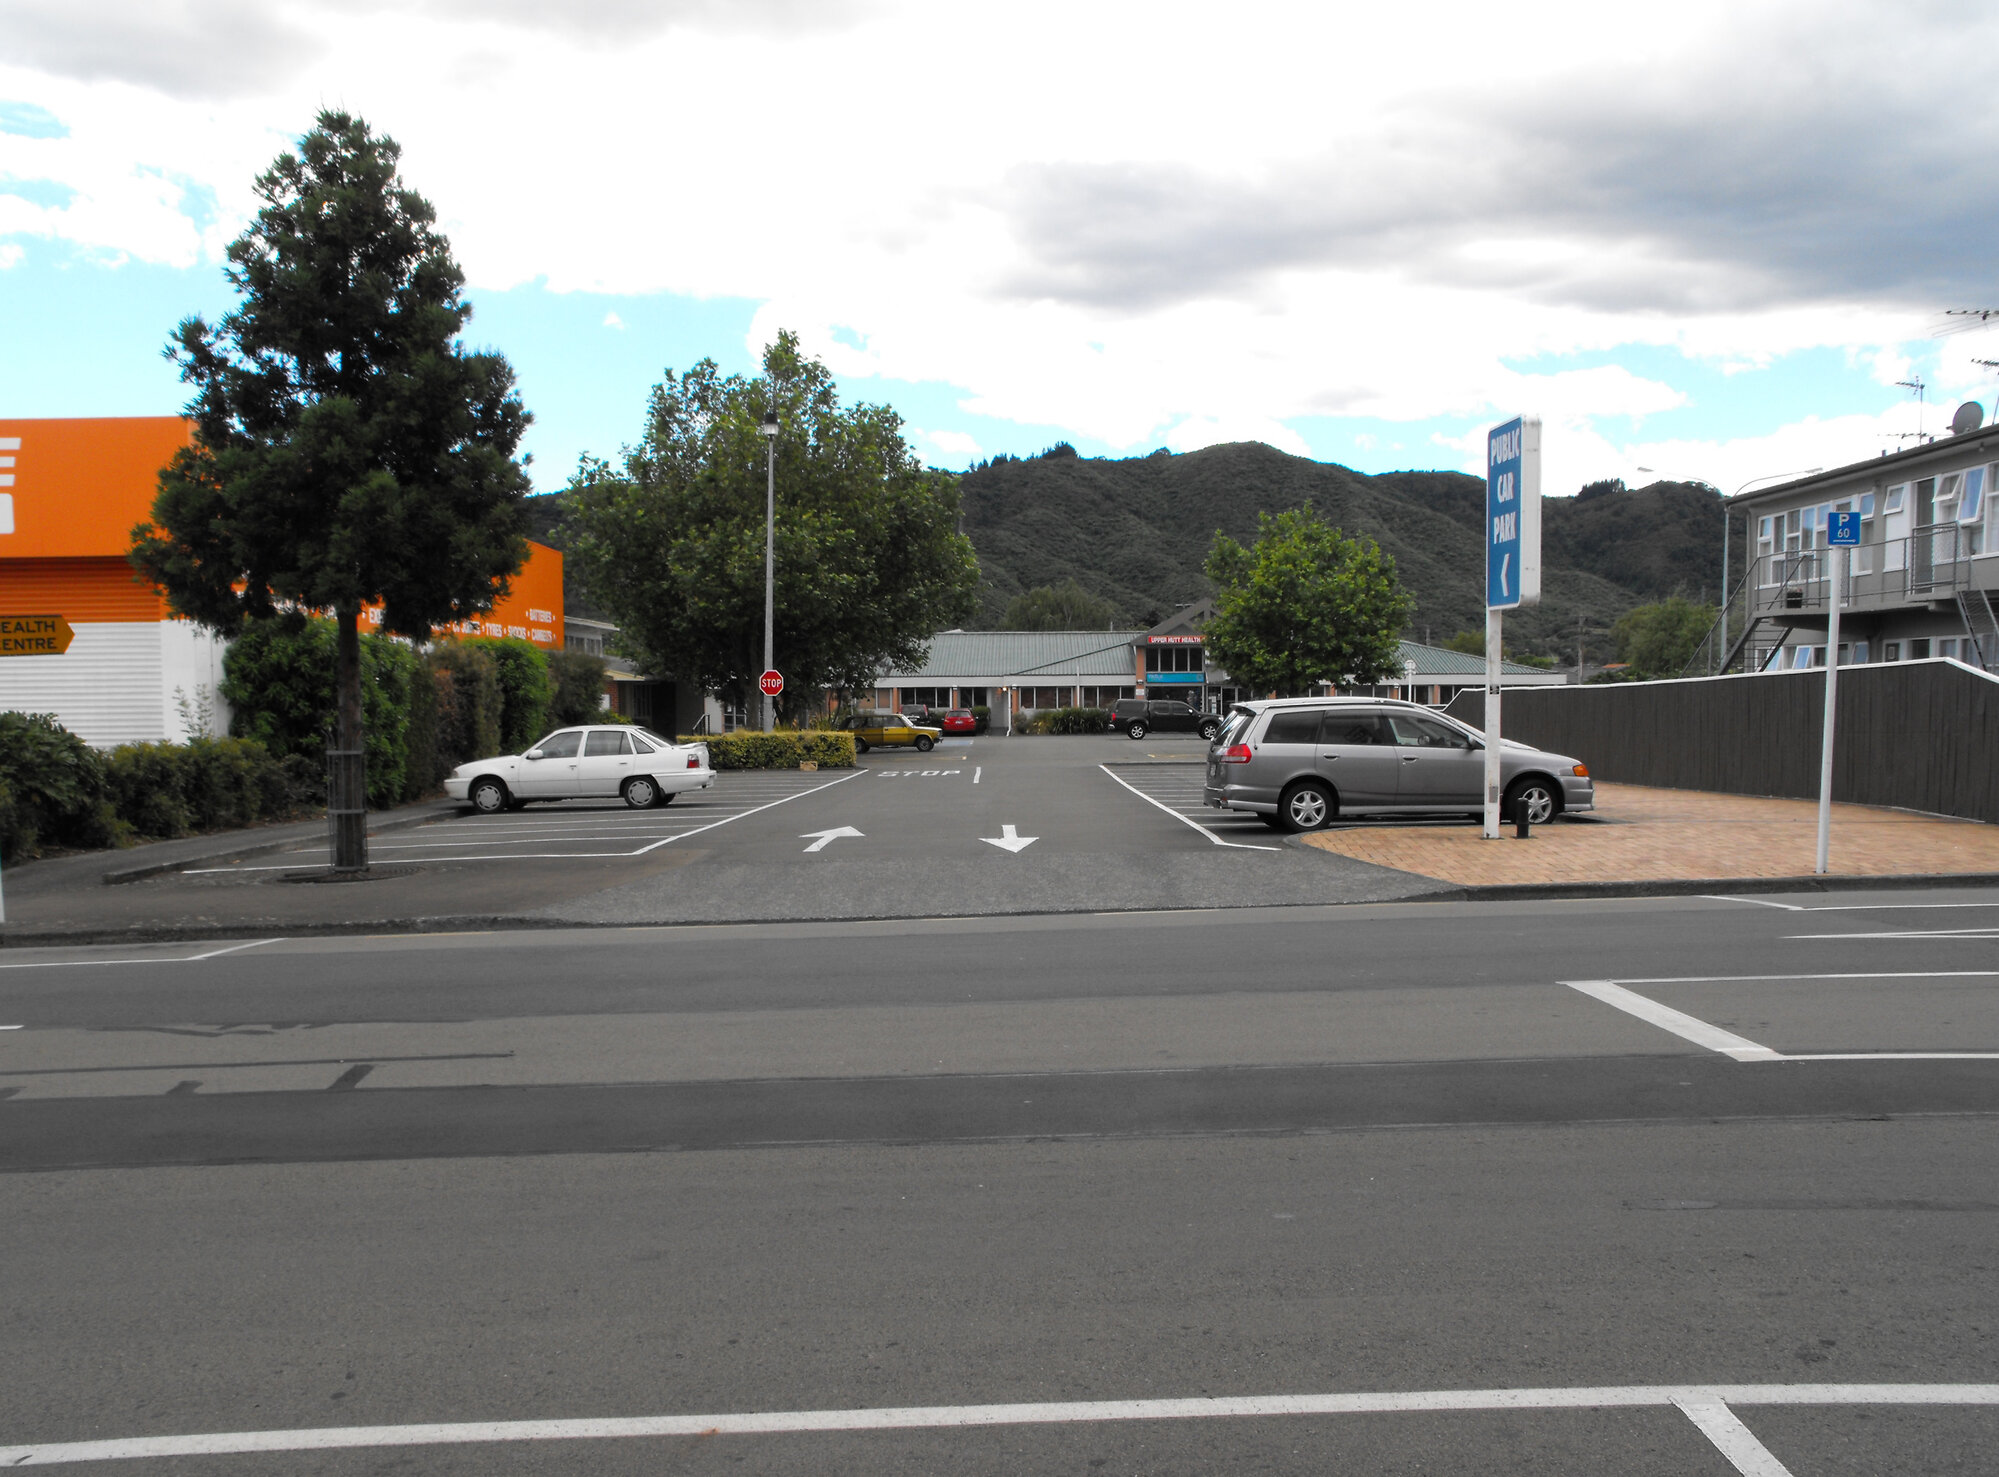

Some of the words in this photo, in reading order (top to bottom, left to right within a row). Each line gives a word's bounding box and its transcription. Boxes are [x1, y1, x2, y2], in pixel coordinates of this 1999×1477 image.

[1490, 428, 1520, 467] PUBLIC
[1497, 472, 1514, 504] CAR
[1838, 513, 1850, 526] P
[1493, 512, 1516, 545] PARK
[1837, 528, 1850, 538] 60
[0, 620, 56, 633] EALTH
[0, 637, 57, 650] ENTRE
[761, 678, 782, 688] STOP
